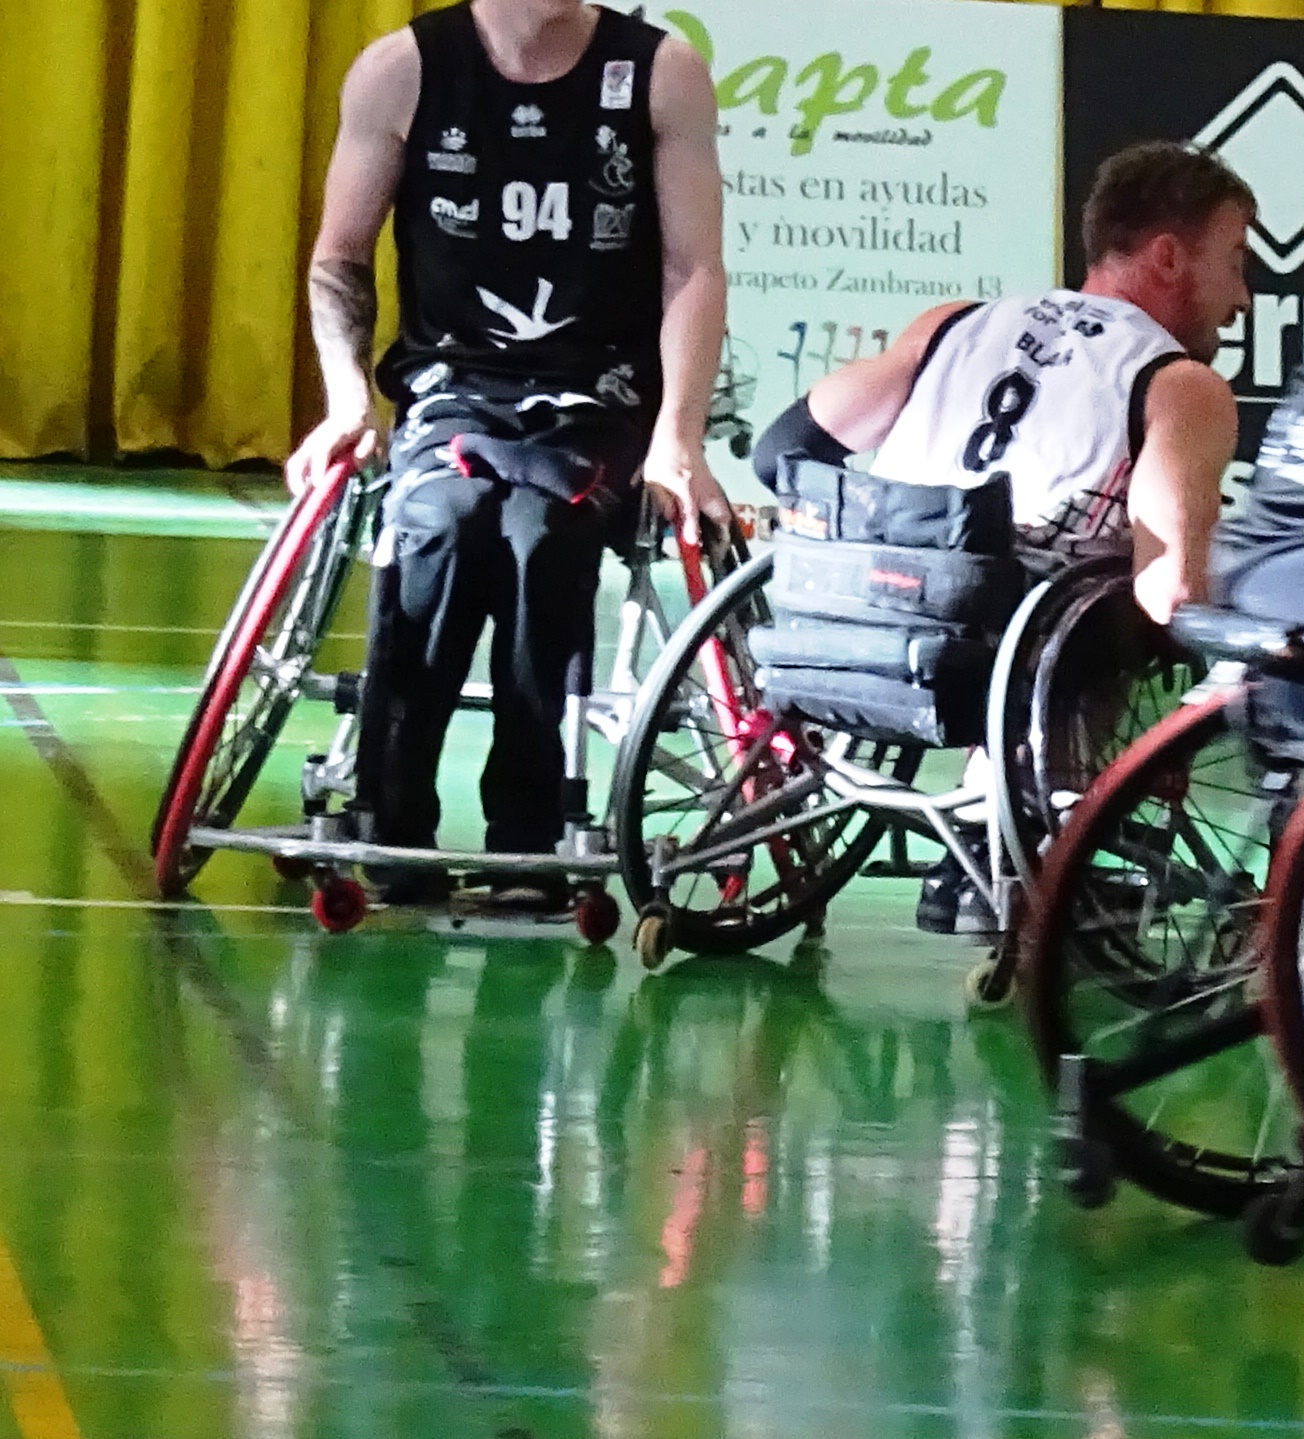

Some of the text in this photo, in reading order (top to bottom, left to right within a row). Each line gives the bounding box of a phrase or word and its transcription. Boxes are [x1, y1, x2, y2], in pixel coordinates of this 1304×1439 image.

[501, 180, 573, 242] 94
[722, 169, 989, 215] stas en ayudas
[738, 215, 964, 256] y movilidad
[727, 270, 818, 295] rapeto
[825, 266, 963, 297] Zambrano
[960, 366, 1041, 474] 8
